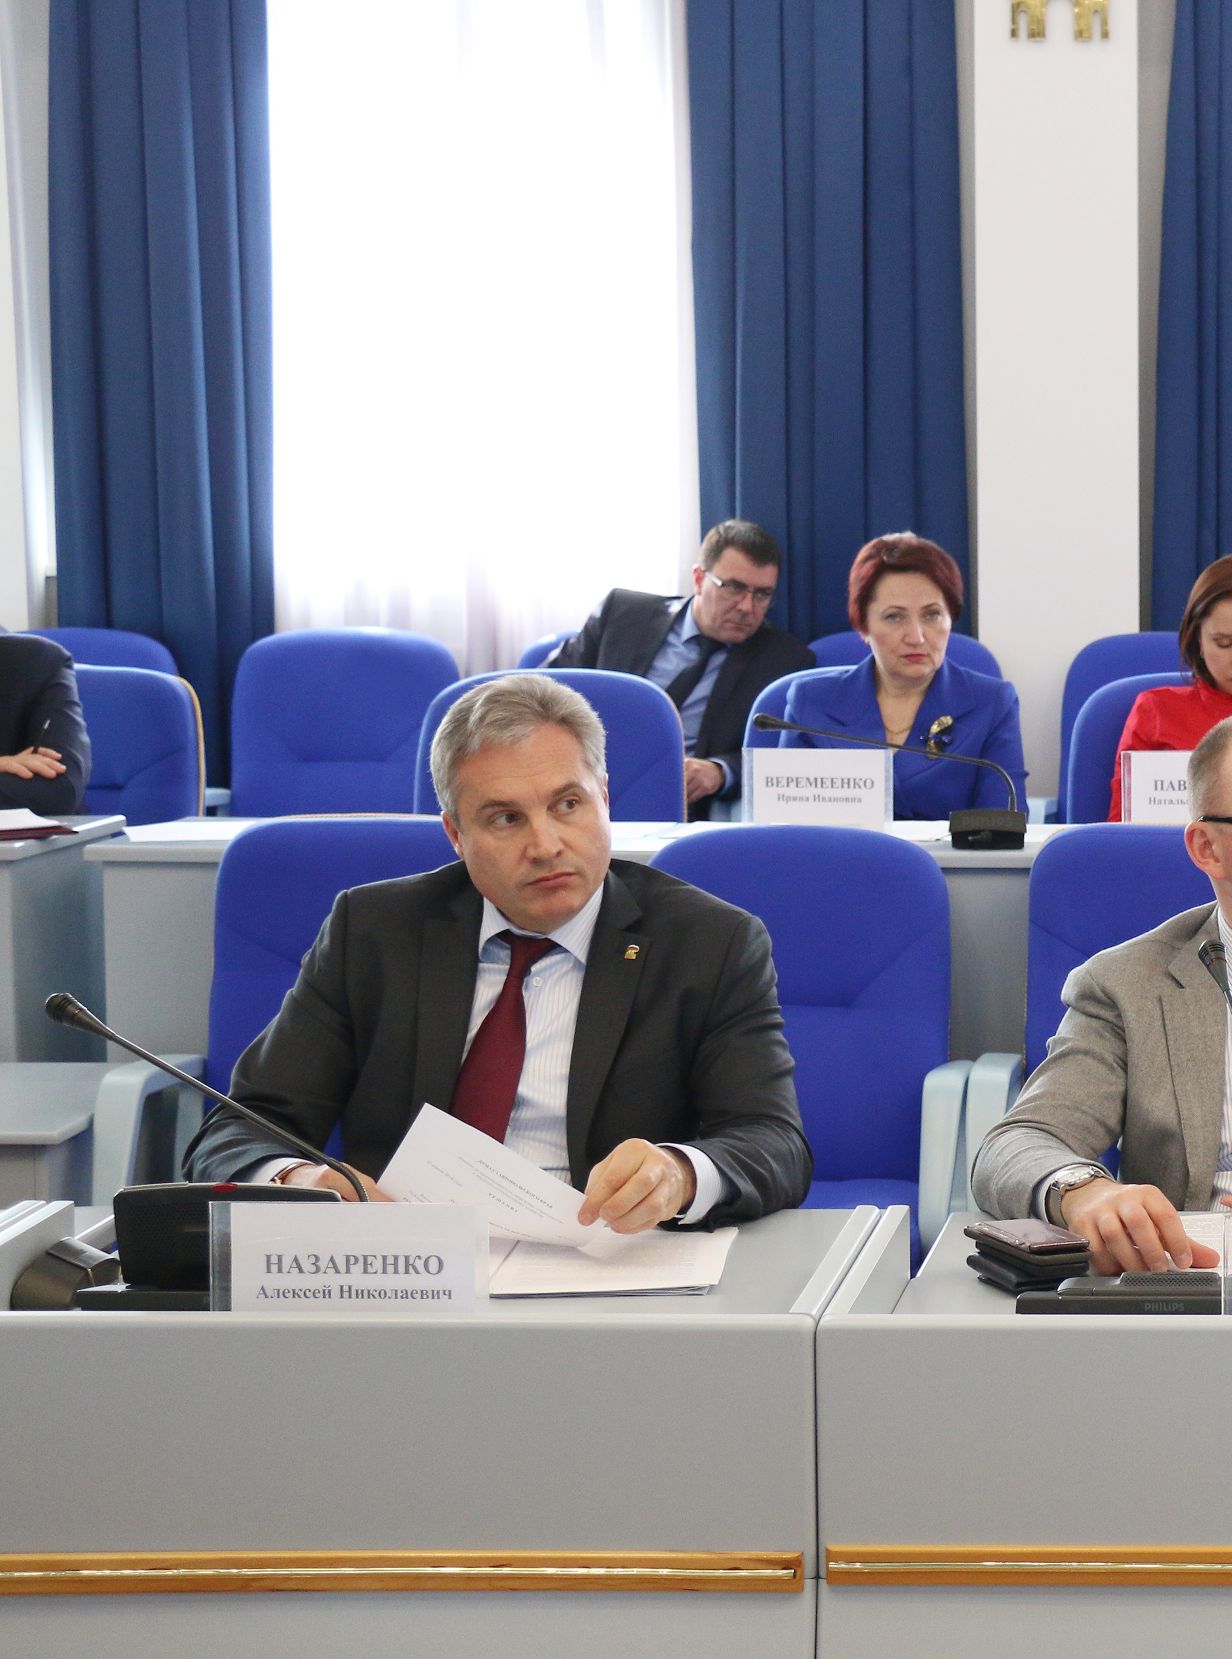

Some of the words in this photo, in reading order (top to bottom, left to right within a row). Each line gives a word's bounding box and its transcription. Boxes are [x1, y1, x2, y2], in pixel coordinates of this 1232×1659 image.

[765, 776, 875, 790] ВЕРЕМЕЕНКО
[1154, 779, 1187, 791] ПАВ
[265, 1253, 445, 1276] НАЗАРЕНКО
[256, 1284, 333, 1299] Алексей
[338, 1284, 453, 1300] Николаевич
[1144, 1302, 1185, 1312] PHILIPS
